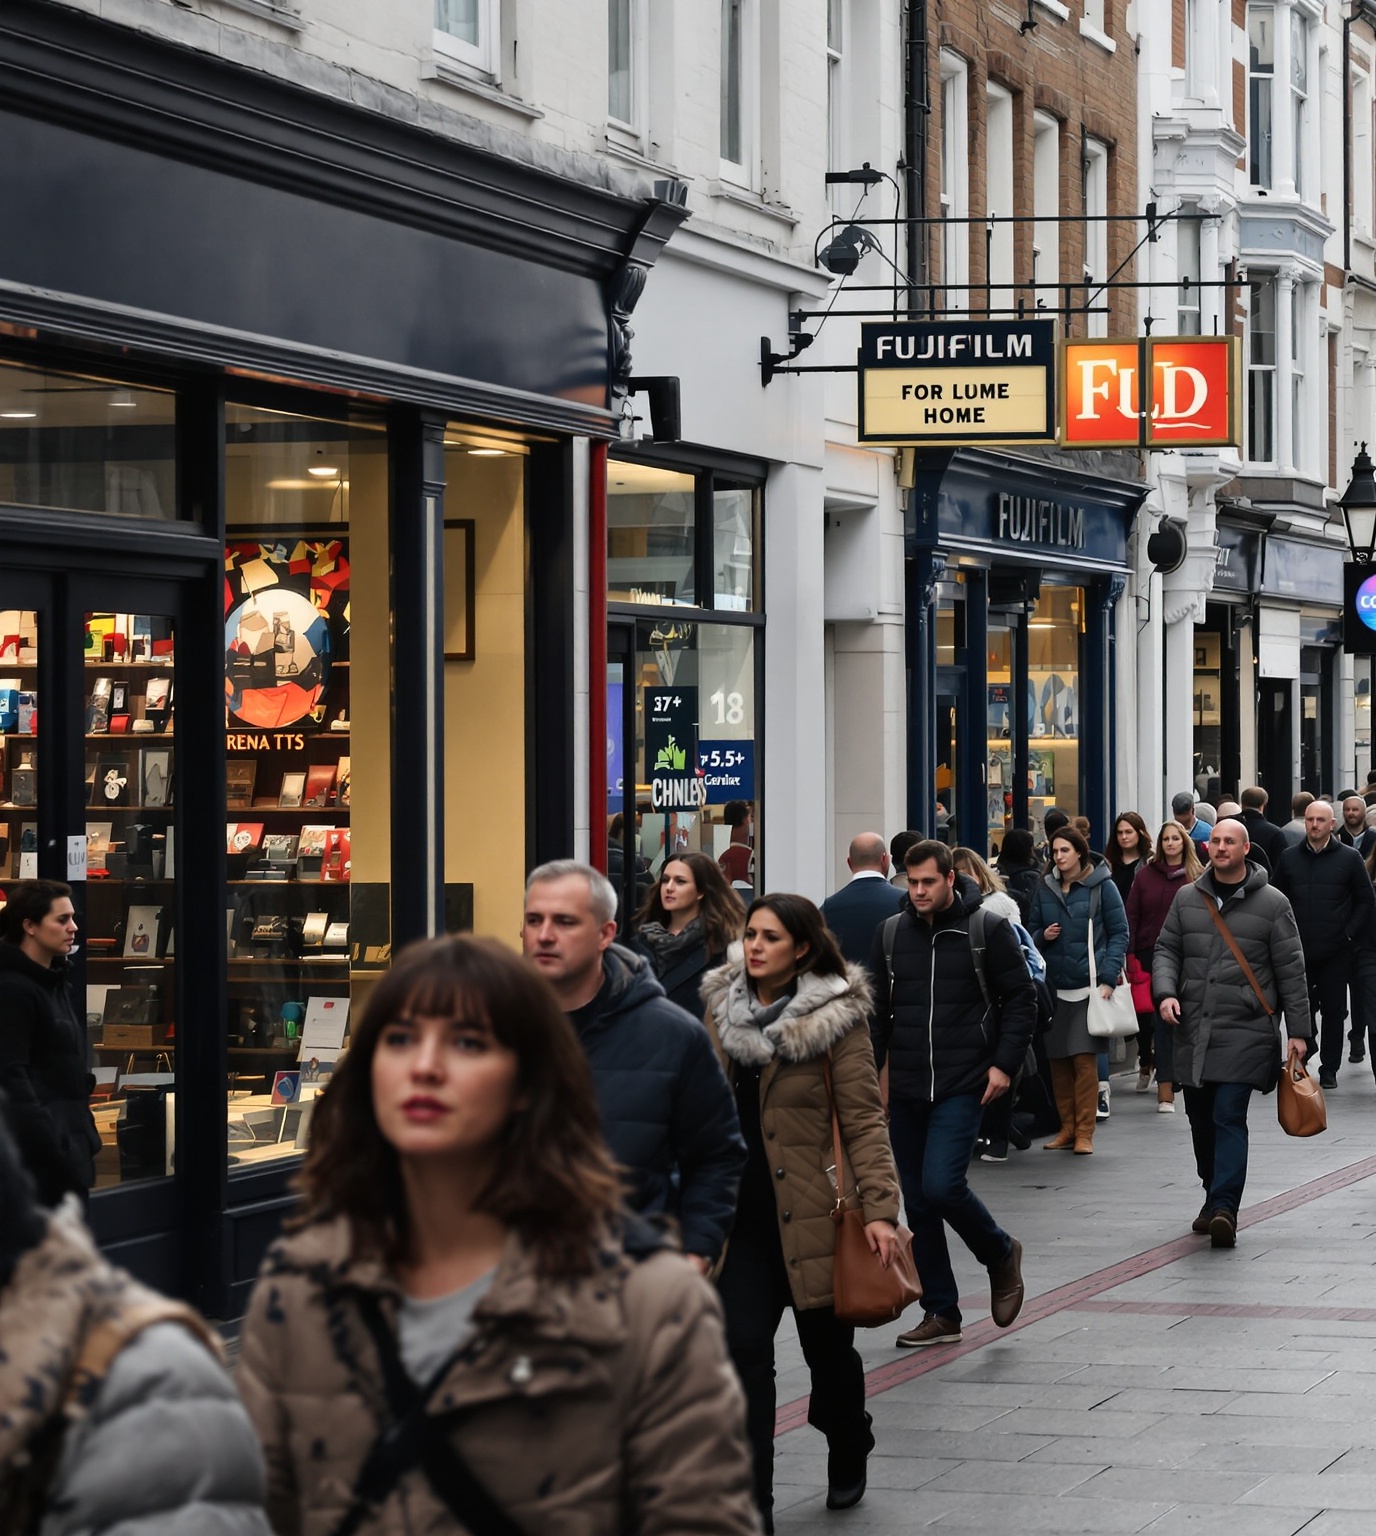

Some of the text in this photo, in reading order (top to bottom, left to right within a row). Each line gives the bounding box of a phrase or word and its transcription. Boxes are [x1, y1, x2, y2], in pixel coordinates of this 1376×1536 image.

[876, 334, 1032, 359] FUJIFILM
[902, 383, 1010, 400] FOR LUME
[924, 407, 985, 424] HOME
[710, 689, 744, 724] 18
[226, 734, 270, 750] RENA
